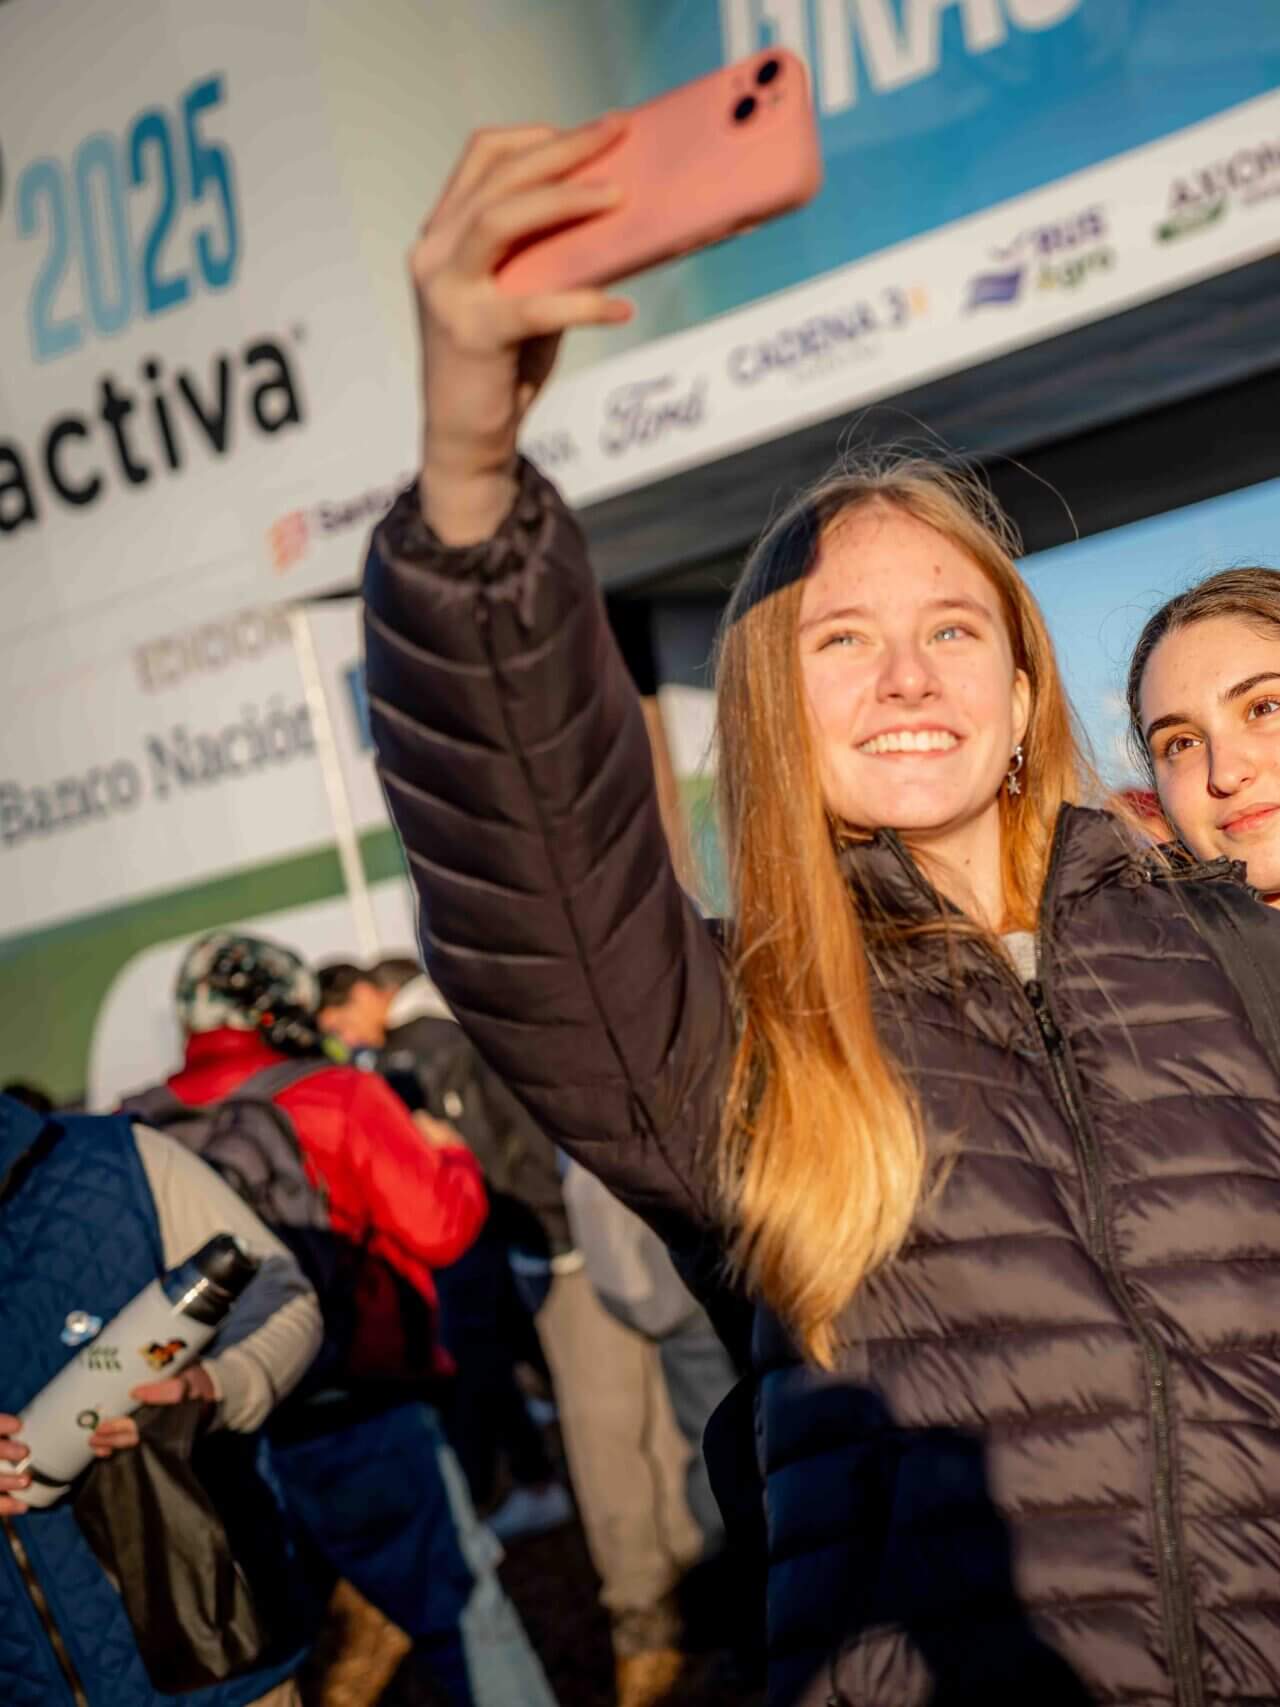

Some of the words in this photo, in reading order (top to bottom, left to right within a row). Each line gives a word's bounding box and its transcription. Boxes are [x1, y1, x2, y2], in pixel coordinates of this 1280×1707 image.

[17, 70, 241, 364] 2025
[728, 303, 874, 386] CADENA
[0, 340, 305, 534] activa
[603, 370, 710, 457] Ford
[0, 758, 142, 847] Banco
